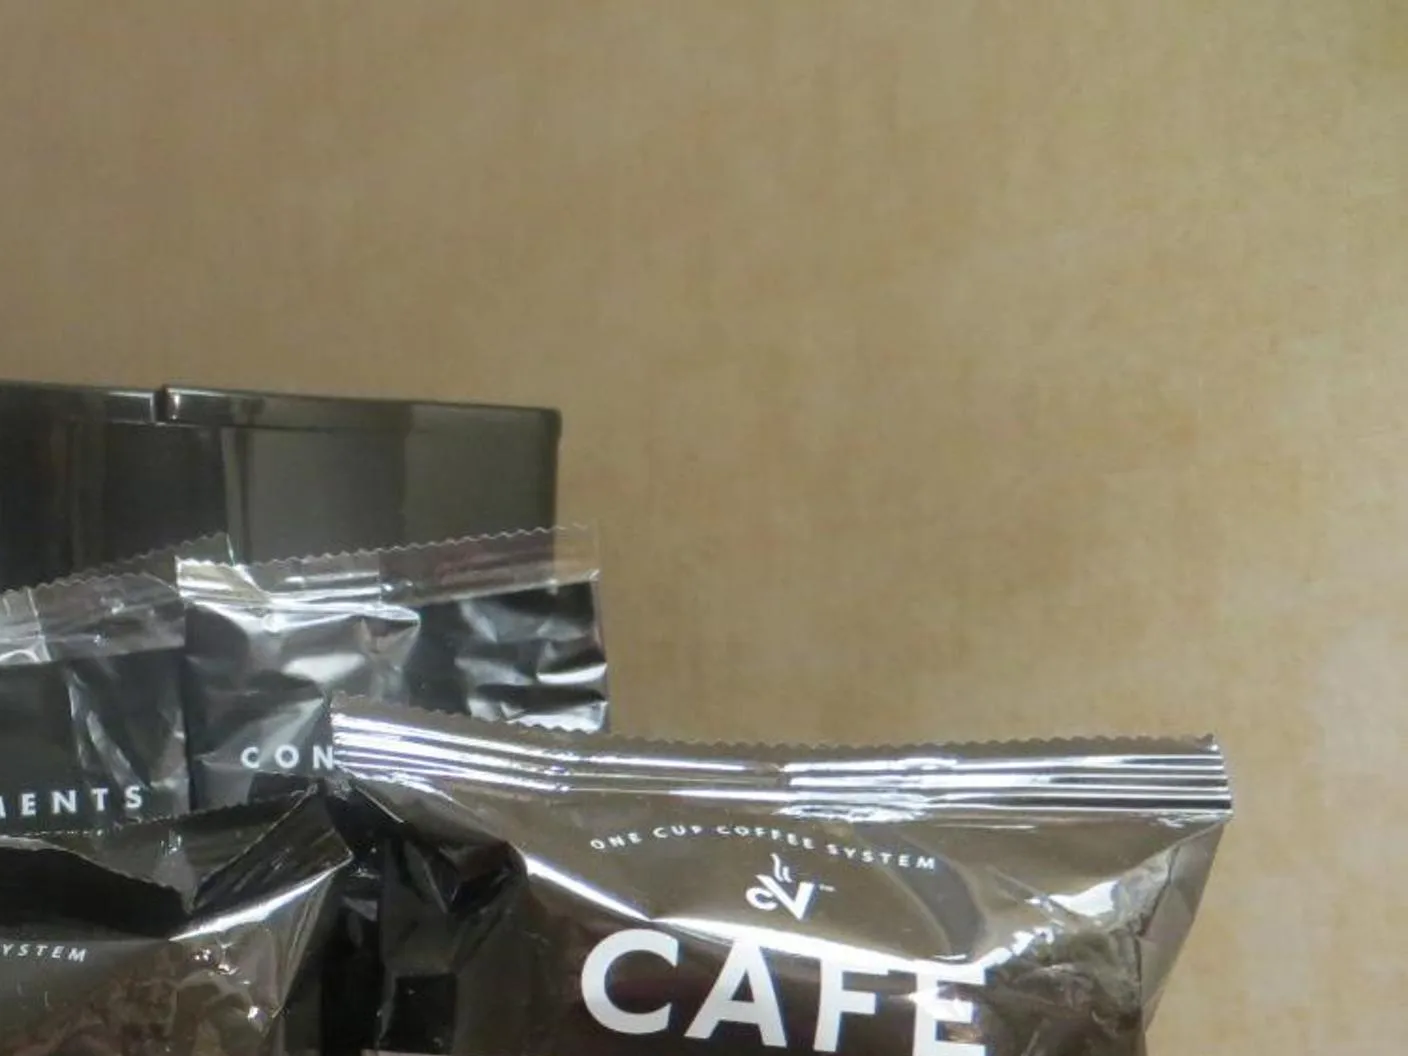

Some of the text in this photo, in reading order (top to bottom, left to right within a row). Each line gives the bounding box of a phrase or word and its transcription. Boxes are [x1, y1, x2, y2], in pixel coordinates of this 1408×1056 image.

[590, 825, 936, 870] ONE CUP COFFEE SYSTEM
